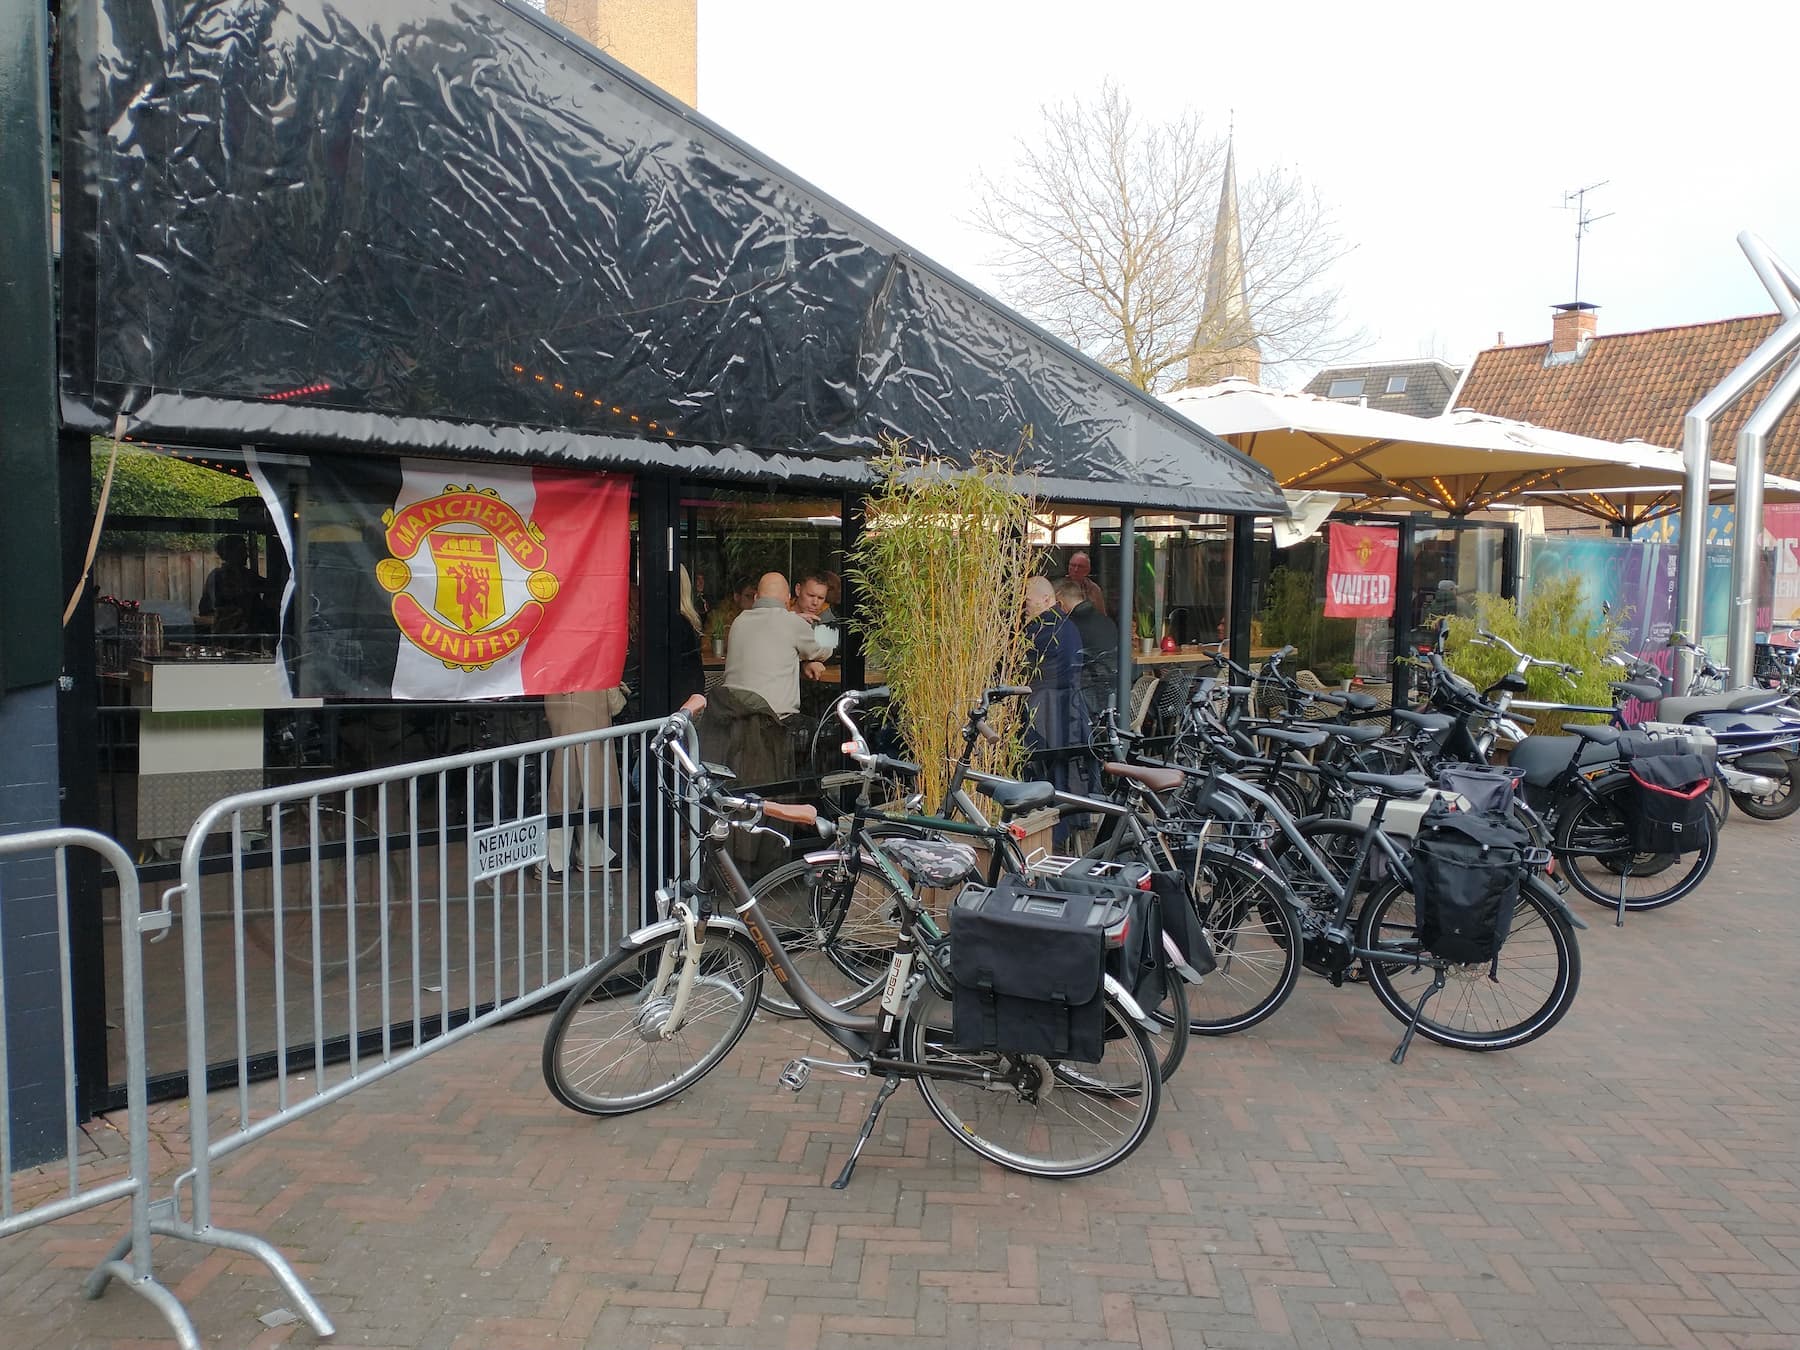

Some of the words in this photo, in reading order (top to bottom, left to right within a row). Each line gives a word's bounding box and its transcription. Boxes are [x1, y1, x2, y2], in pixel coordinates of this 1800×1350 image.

[396, 500, 534, 561] MANCHESTER
[1331, 573, 1391, 606] UNITED
[420, 623, 521, 659] UNITED
[479, 825, 537, 855] NEMACO
[479, 843, 537, 872] VERHUUR
[743, 911, 789, 984] VOGUE
